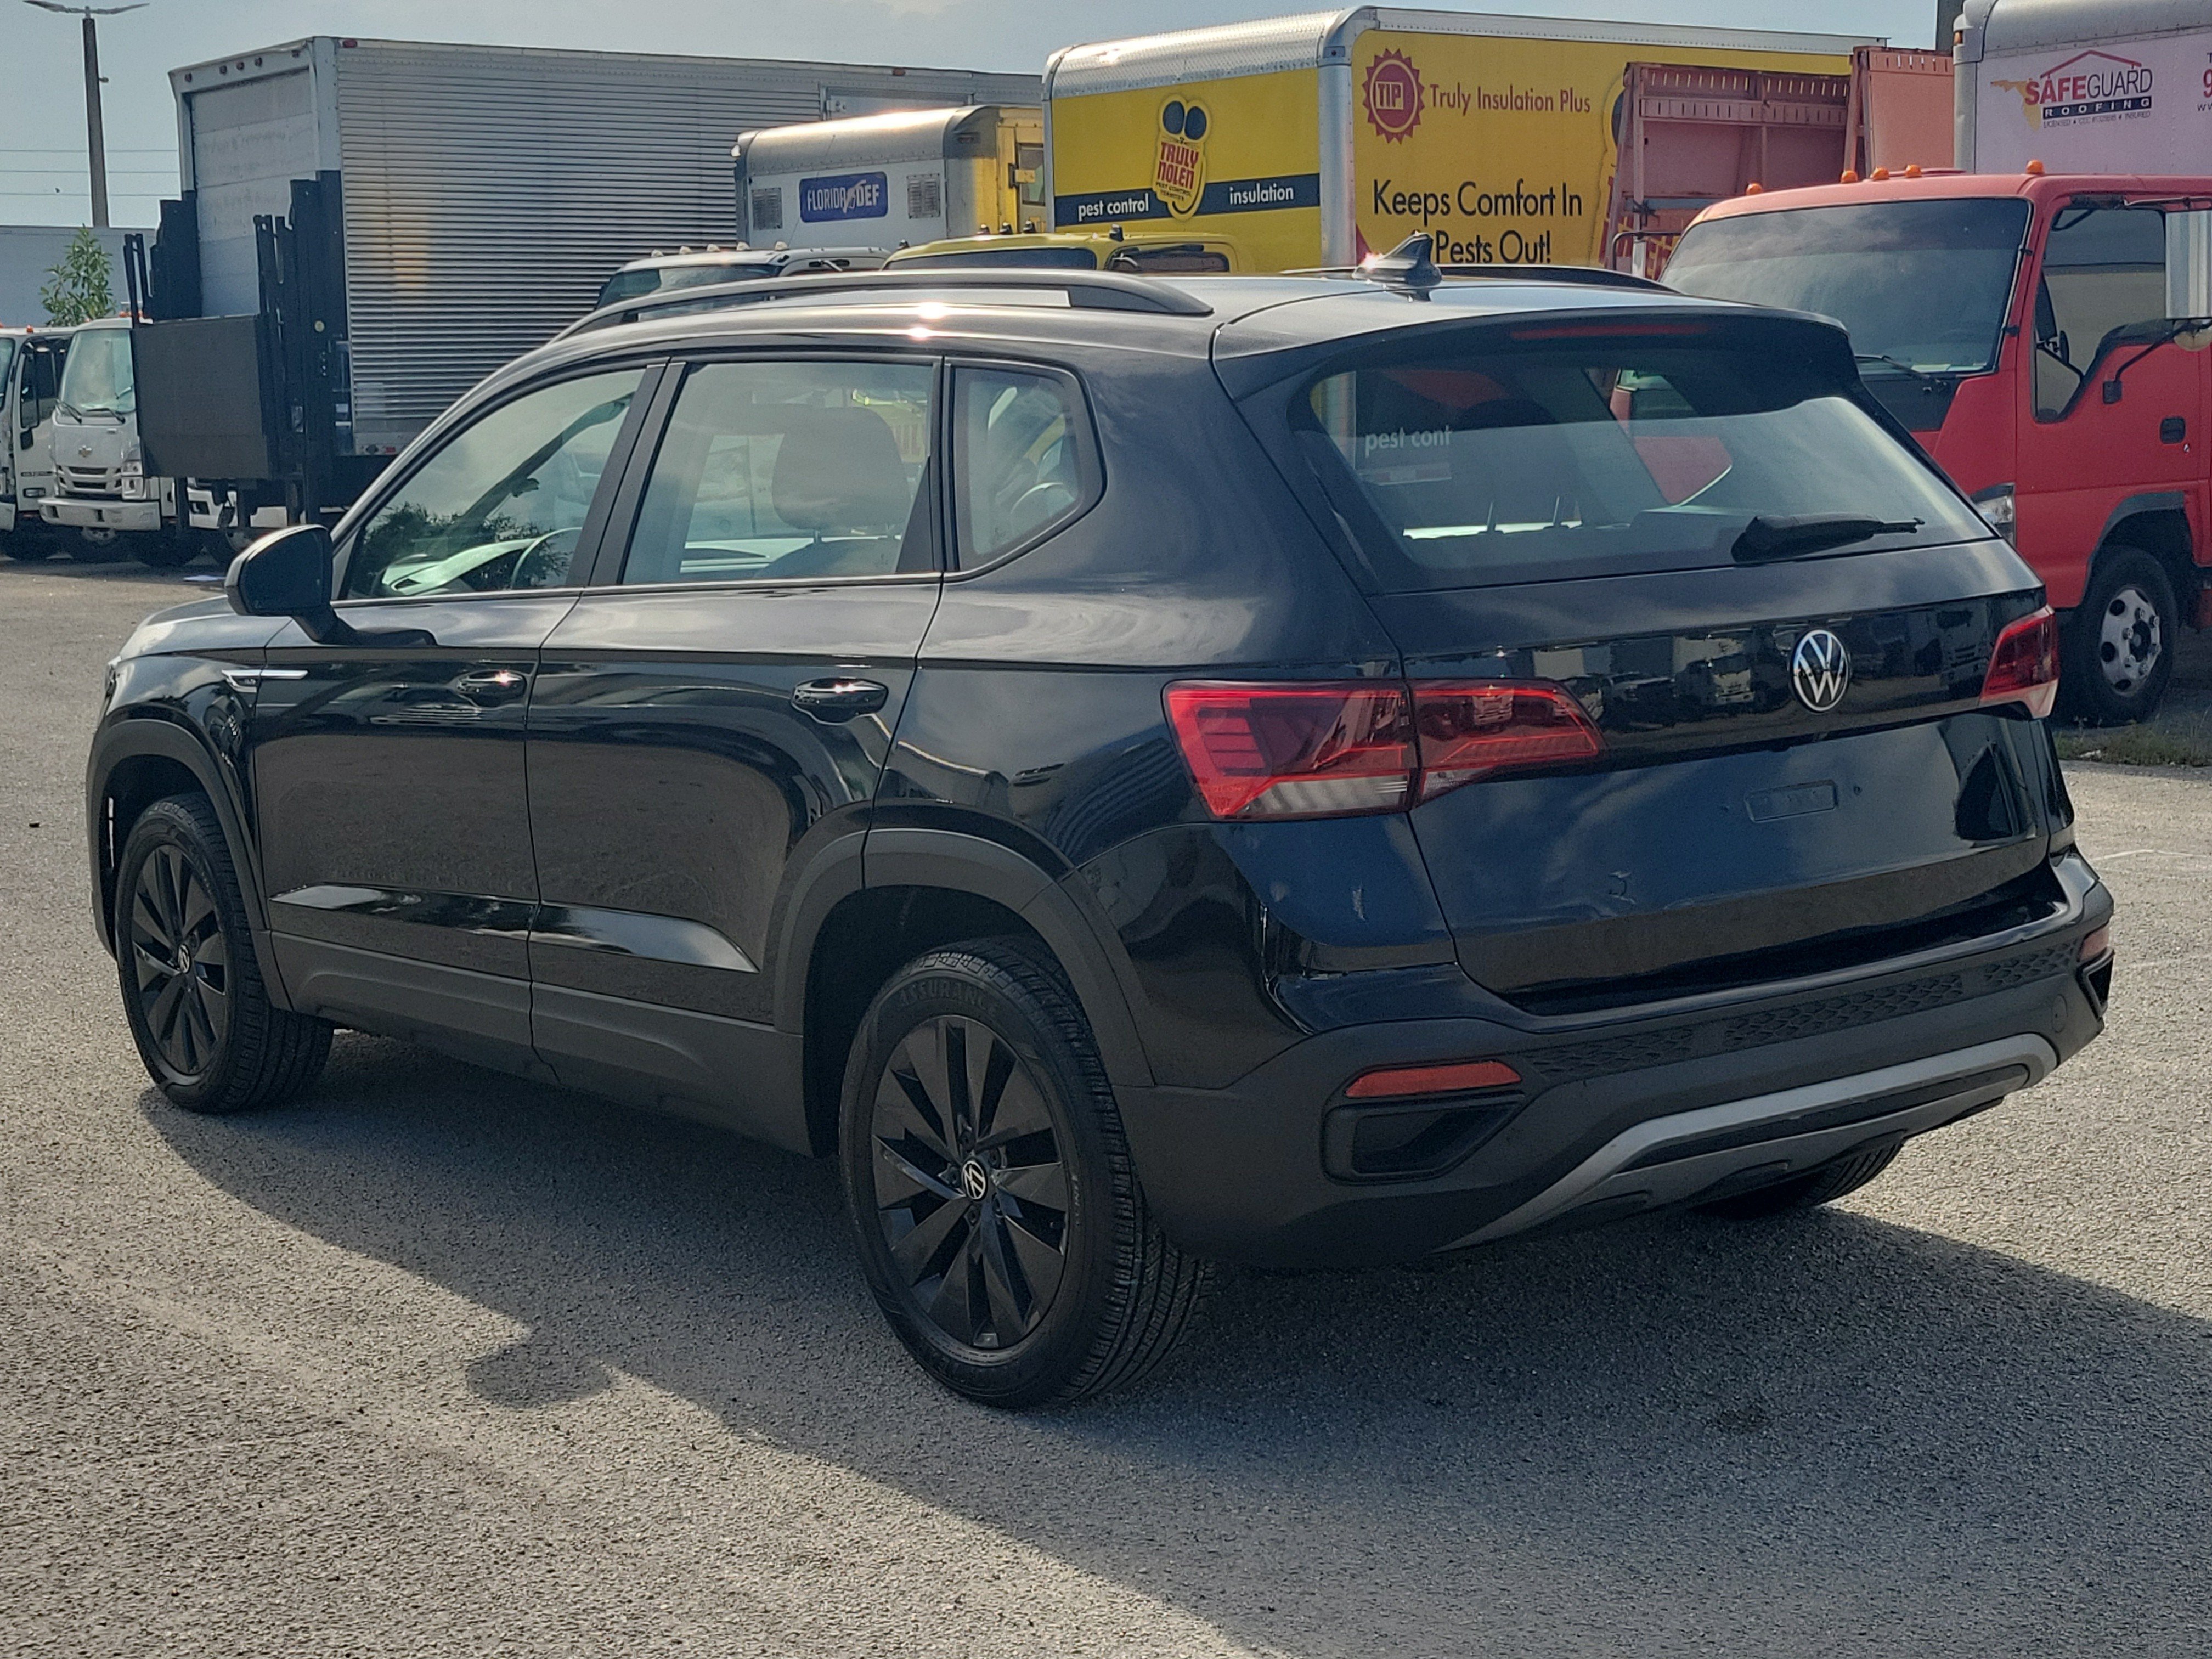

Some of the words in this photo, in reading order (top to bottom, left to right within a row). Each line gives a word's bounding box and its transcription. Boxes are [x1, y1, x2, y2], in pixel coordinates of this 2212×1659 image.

[1377, 83, 1402, 108] TIP
[1430, 82, 1471, 116] Truly
[1477, 84, 1553, 111] Insulation
[1560, 87, 1590, 113] Plus
[2025, 69, 2153, 105] SAFEGUARD
[2045, 98, 2150, 117] ROOFING
[1160, 141, 1199, 169] TRULY
[1157, 161, 1195, 190] NOLEN
[807, 187, 846, 212] FLORIDA
[856, 184, 879, 206] DEF
[1078, 201, 1103, 221] pest
[1107, 194, 1149, 215] control
[1229, 183, 1294, 205] insulation
[1373, 179, 1451, 227] Keeps
[1457, 178, 1556, 216] Comfort
[1562, 182, 1582, 216] In
[1436, 230, 1493, 264] Pests
[1500, 229, 1551, 264] Out!
[1365, 426, 1406, 458] pest
[899, 978, 1003, 1015] ASSURANC
